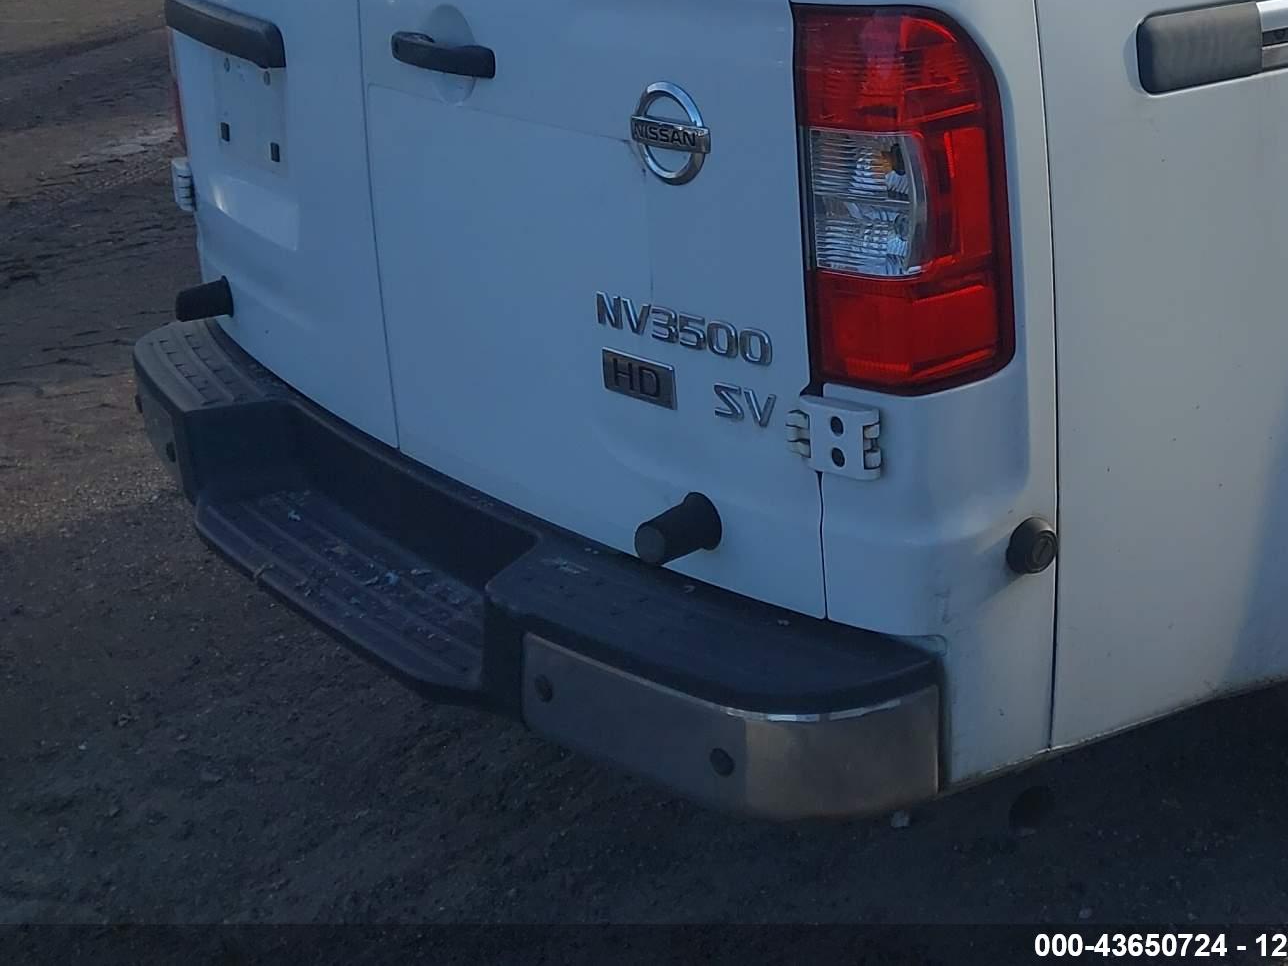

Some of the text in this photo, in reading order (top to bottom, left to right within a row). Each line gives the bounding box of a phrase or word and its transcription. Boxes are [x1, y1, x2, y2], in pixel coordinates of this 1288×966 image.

[634, 120, 697, 147] NISSAN
[596, 291, 773, 365] NV3500
[611, 357, 661, 400] HD
[713, 382, 777, 428] SV
